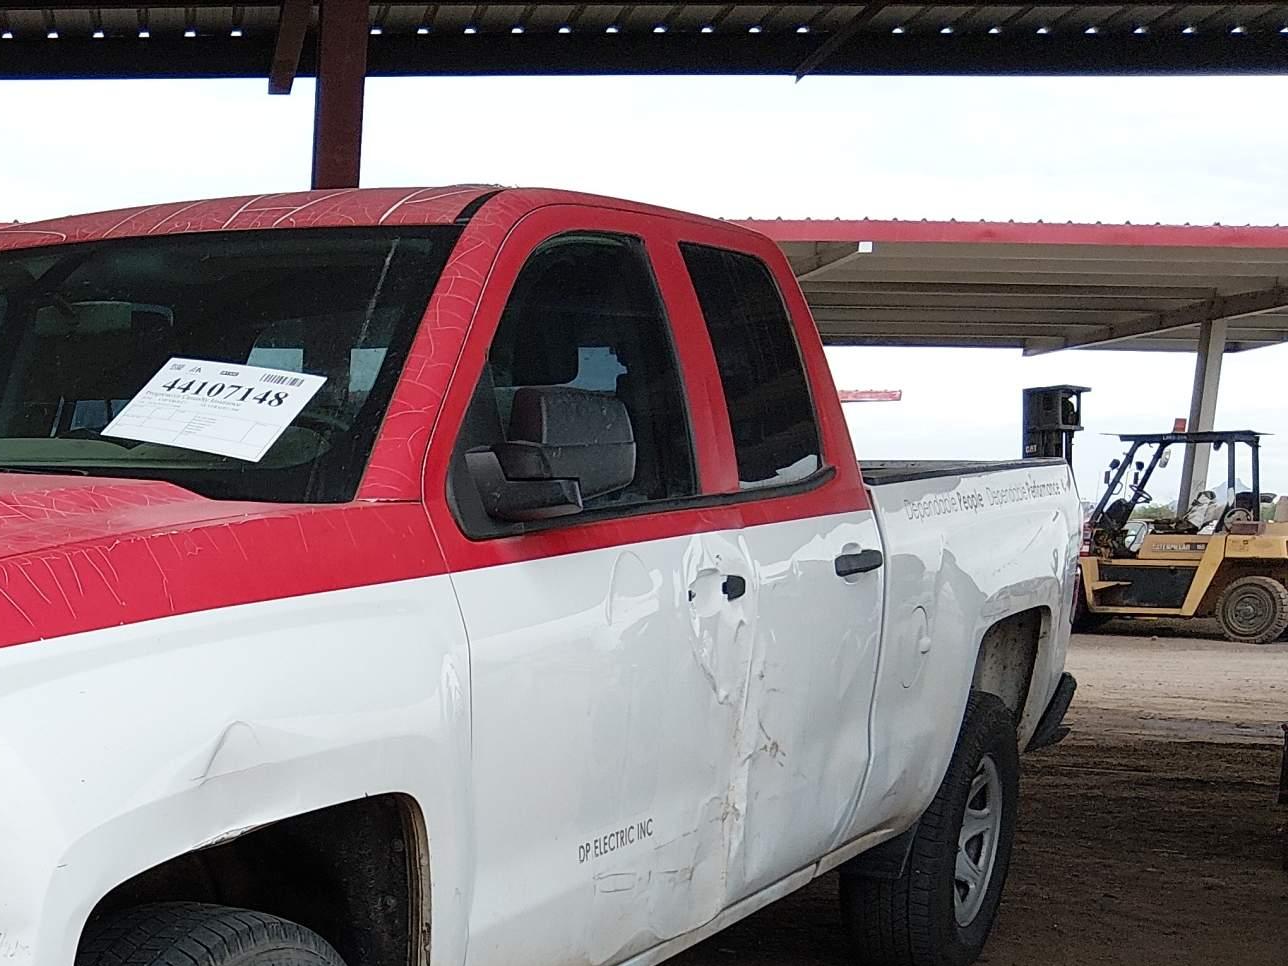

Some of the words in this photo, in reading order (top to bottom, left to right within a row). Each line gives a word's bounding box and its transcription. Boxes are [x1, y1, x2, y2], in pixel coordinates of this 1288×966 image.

[161, 376, 289, 408] 44107148
[1025, 444, 1037, 454] CAT
[578, 842, 591, 863] DP
[593, 825, 635, 858] ELECTRIC
[637, 818, 654, 841] INC
